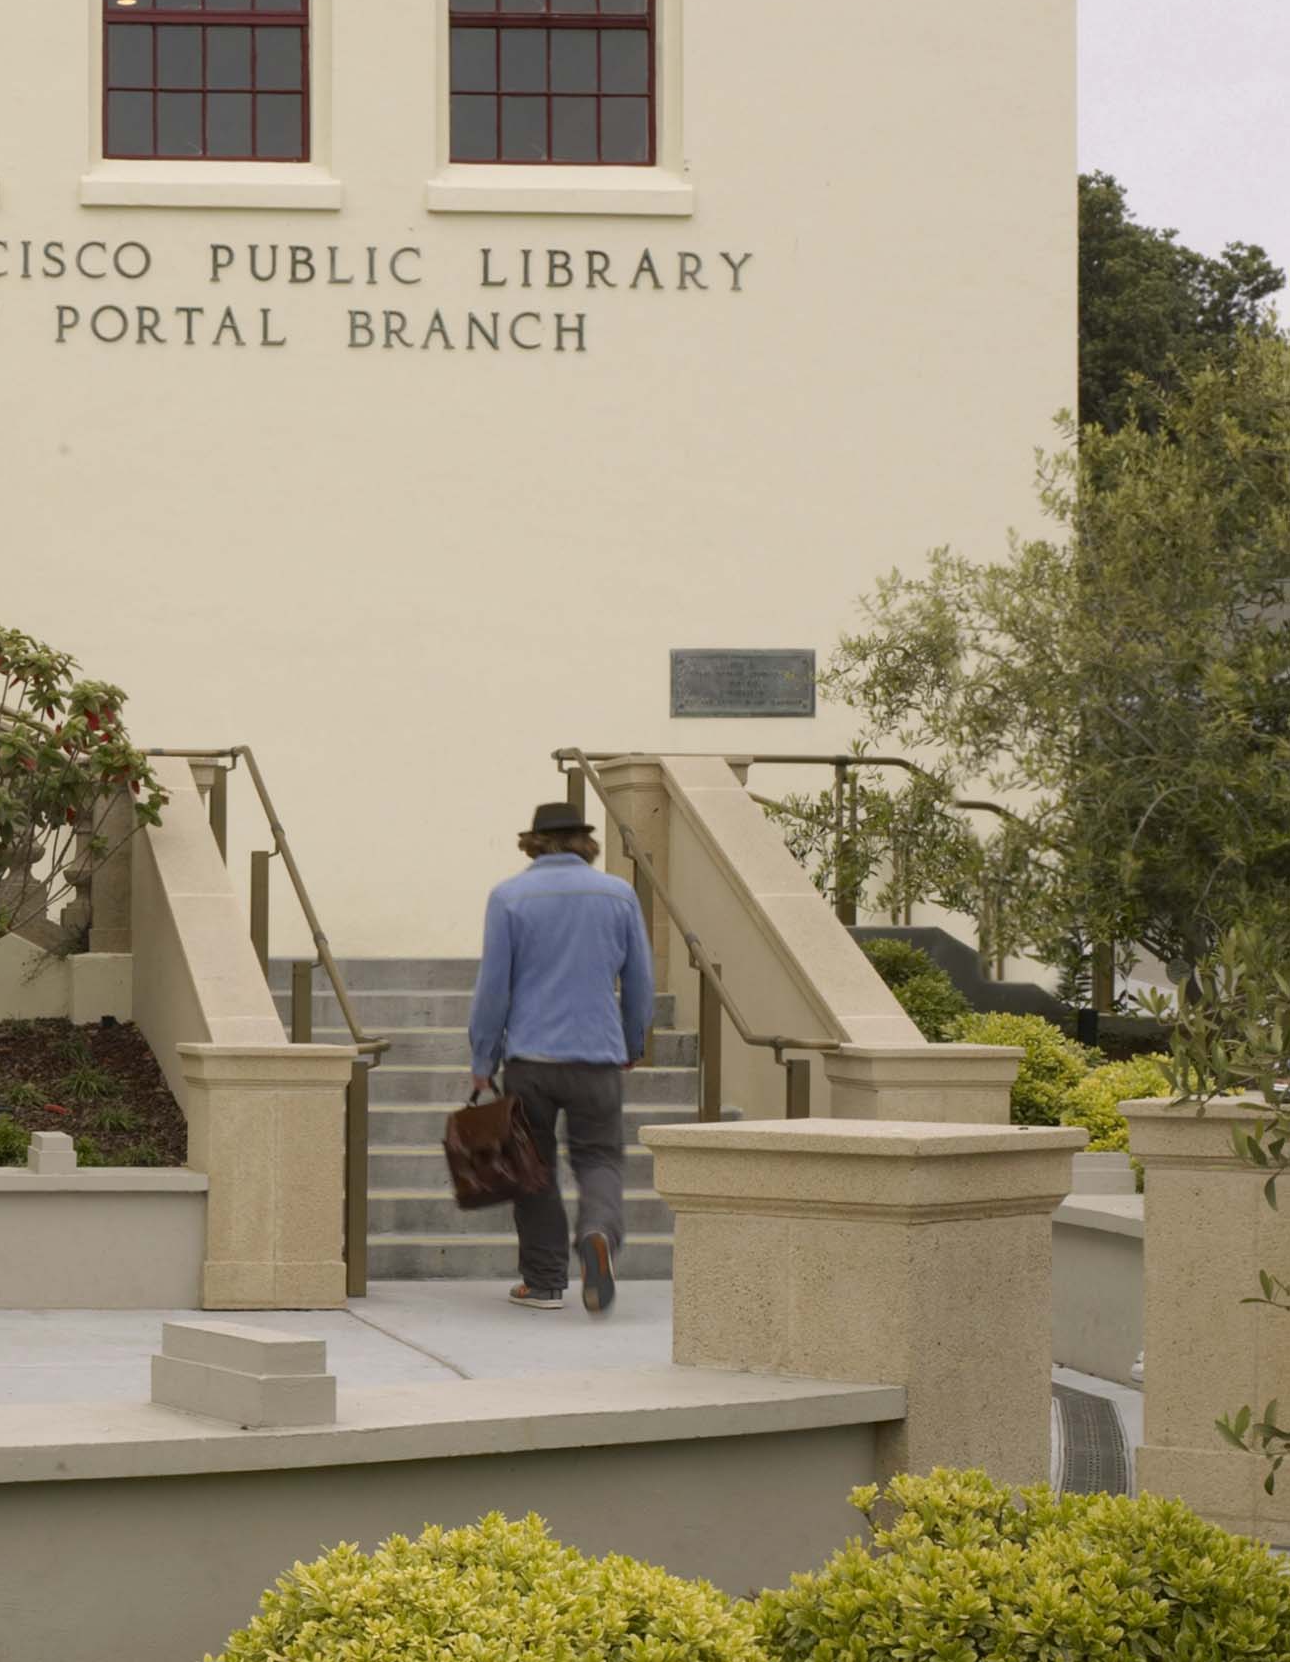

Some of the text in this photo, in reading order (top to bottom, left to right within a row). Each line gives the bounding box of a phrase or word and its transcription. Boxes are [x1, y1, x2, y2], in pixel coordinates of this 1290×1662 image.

[209, 243, 422, 286] PUBLIC
[479, 247, 754, 293] LIBRARY
[54, 304, 287, 349] PORTAL
[347, 308, 587, 353] BRANCH
